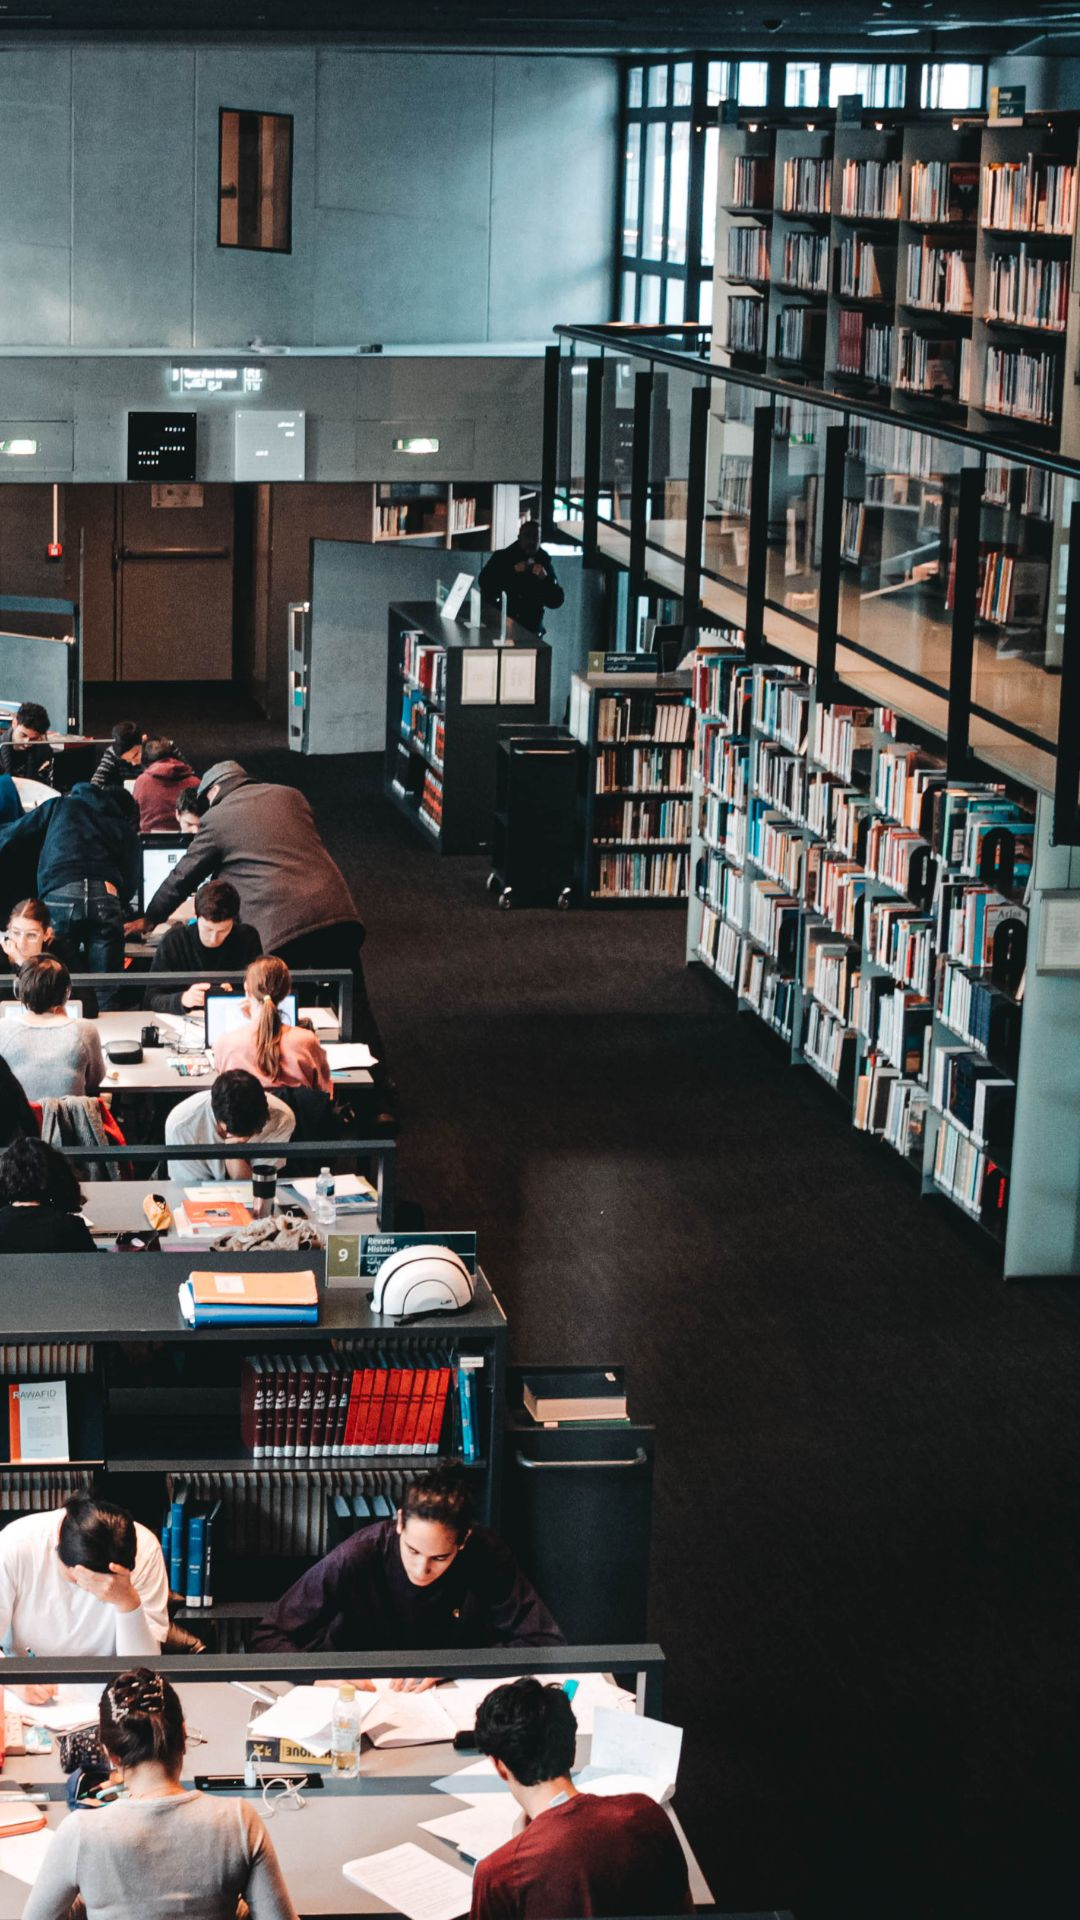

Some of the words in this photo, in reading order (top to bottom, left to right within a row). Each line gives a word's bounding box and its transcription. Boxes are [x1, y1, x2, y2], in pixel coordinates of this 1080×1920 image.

[367, 1237, 395, 1245] Revues
[367, 1245, 398, 1253] Histoire
[338, 1248, 349, 1262] 9
[13, 1389, 57, 1400] RAWAFID
